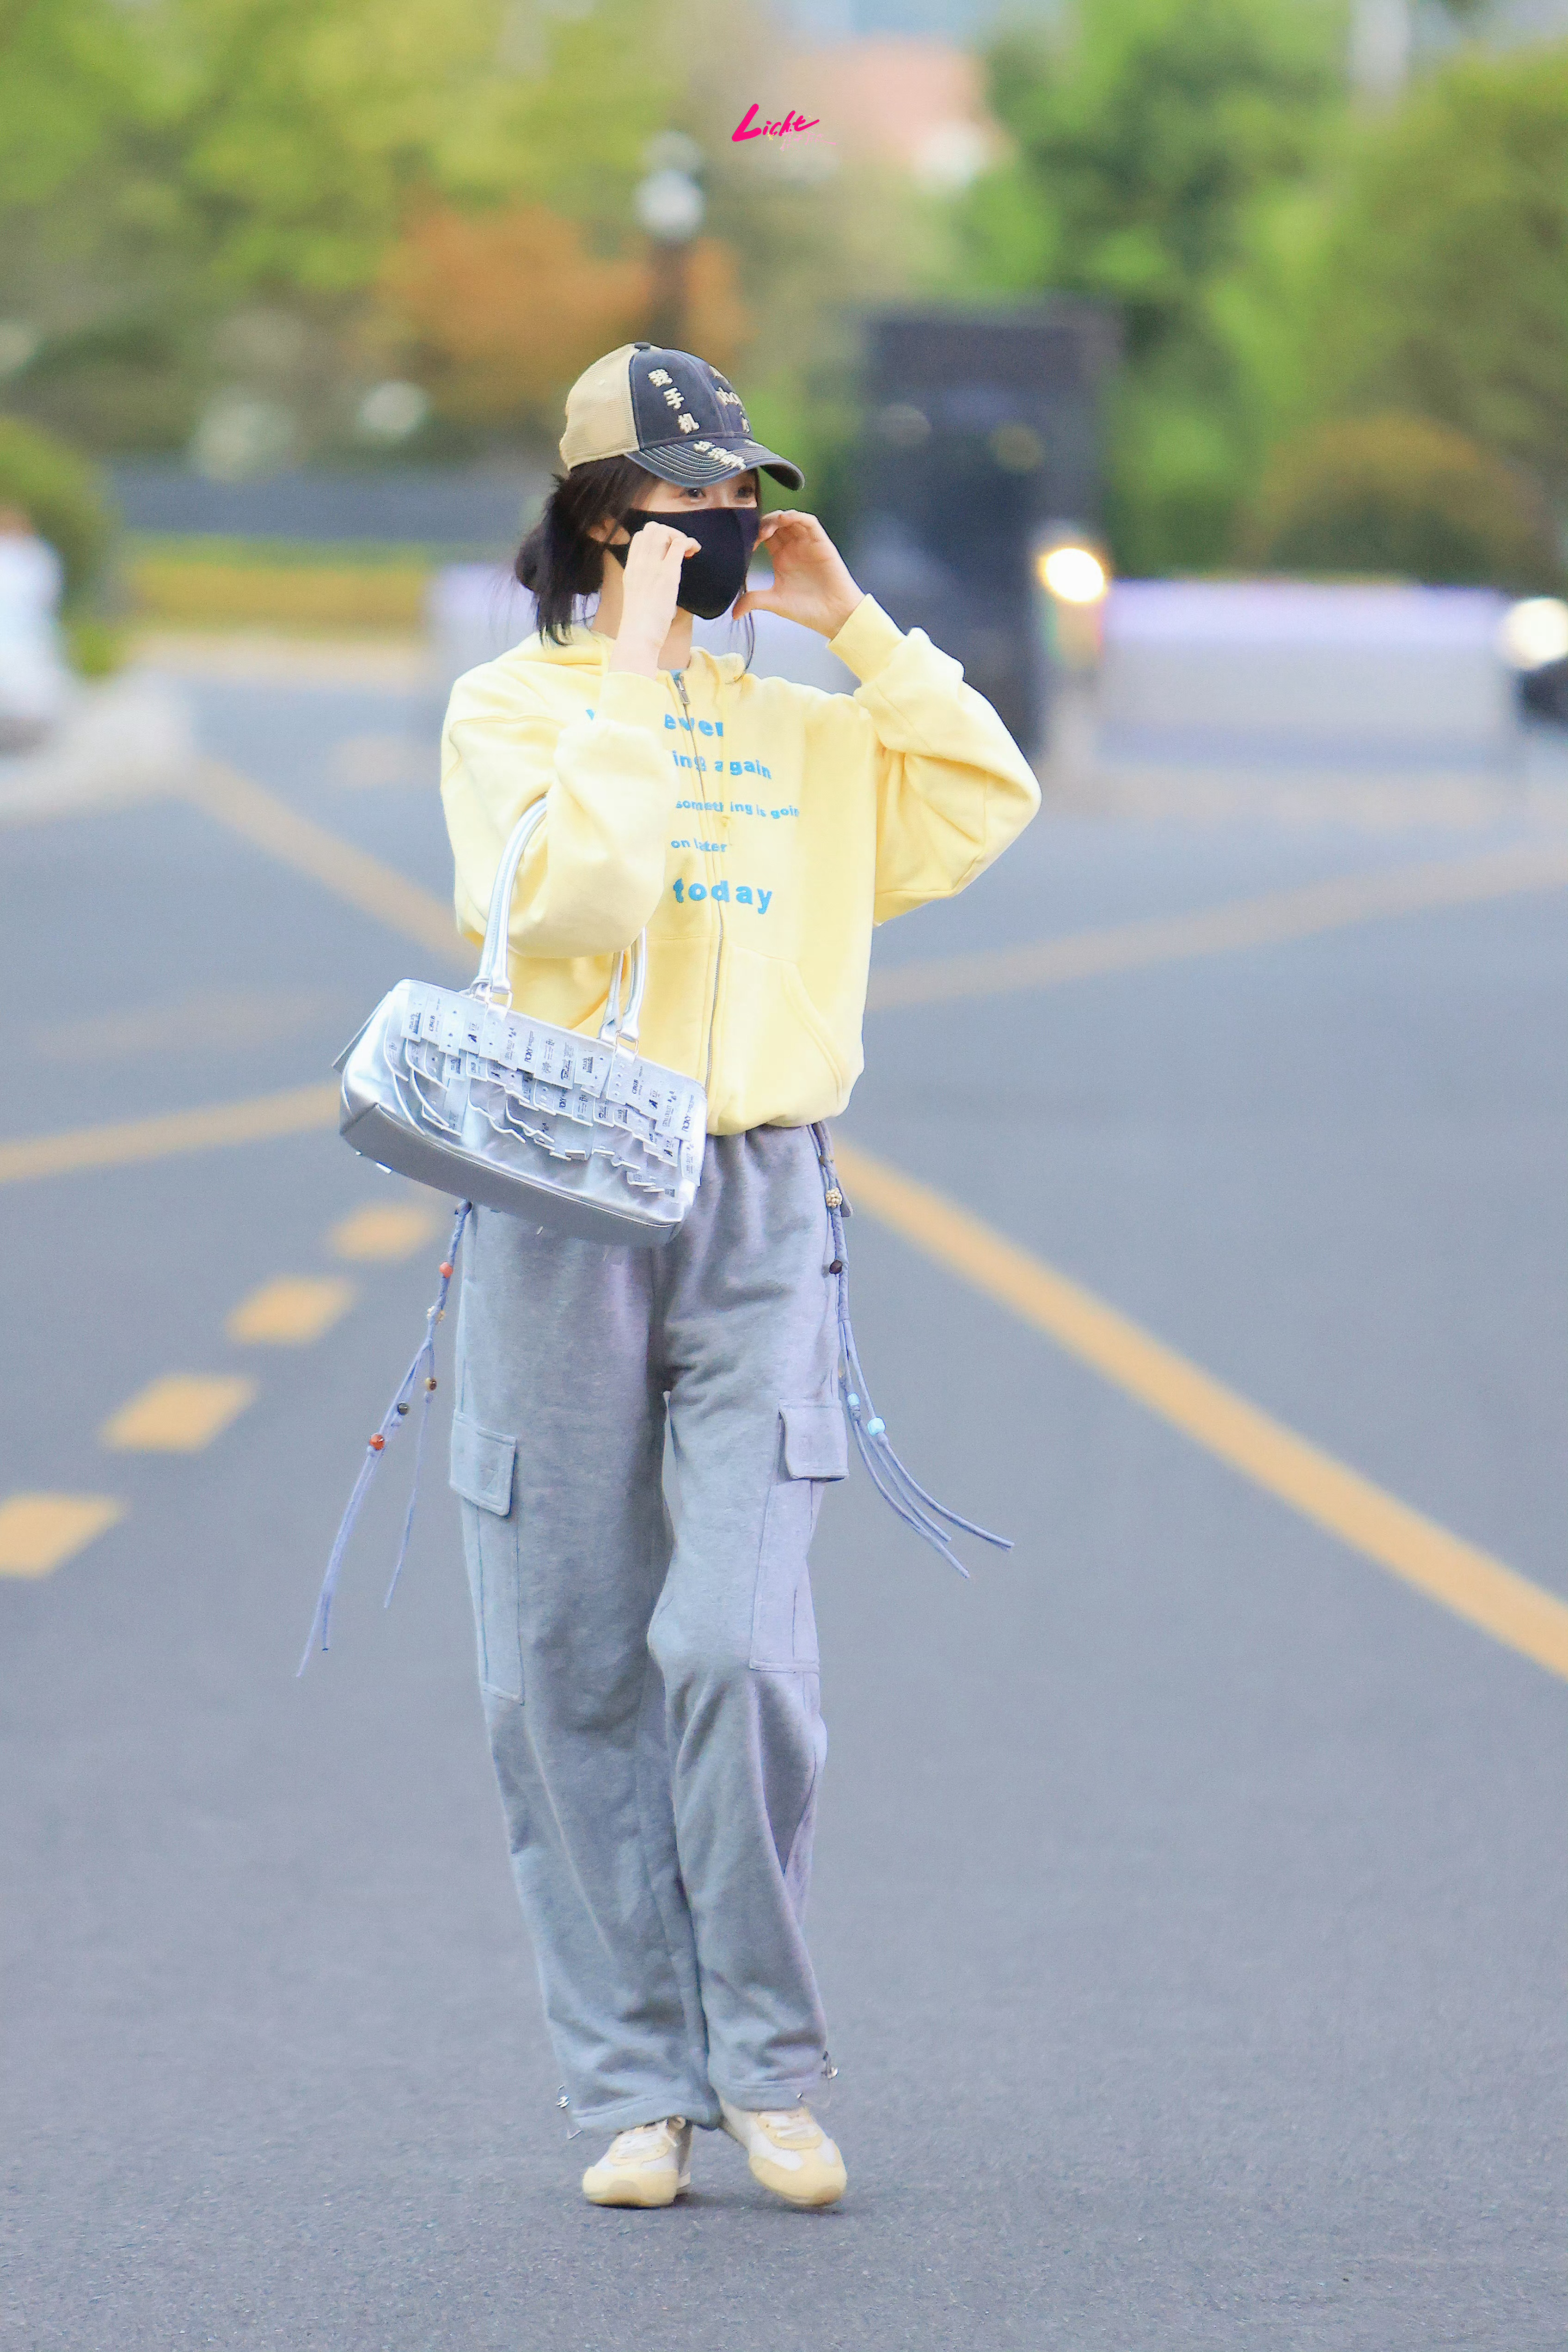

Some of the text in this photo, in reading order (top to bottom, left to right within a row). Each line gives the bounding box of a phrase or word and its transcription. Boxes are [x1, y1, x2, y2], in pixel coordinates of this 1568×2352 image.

[714, 759, 772, 779] again
[756, 804, 766, 817] is
[671, 838, 727, 852] on later
[673, 877, 772, 914] today
